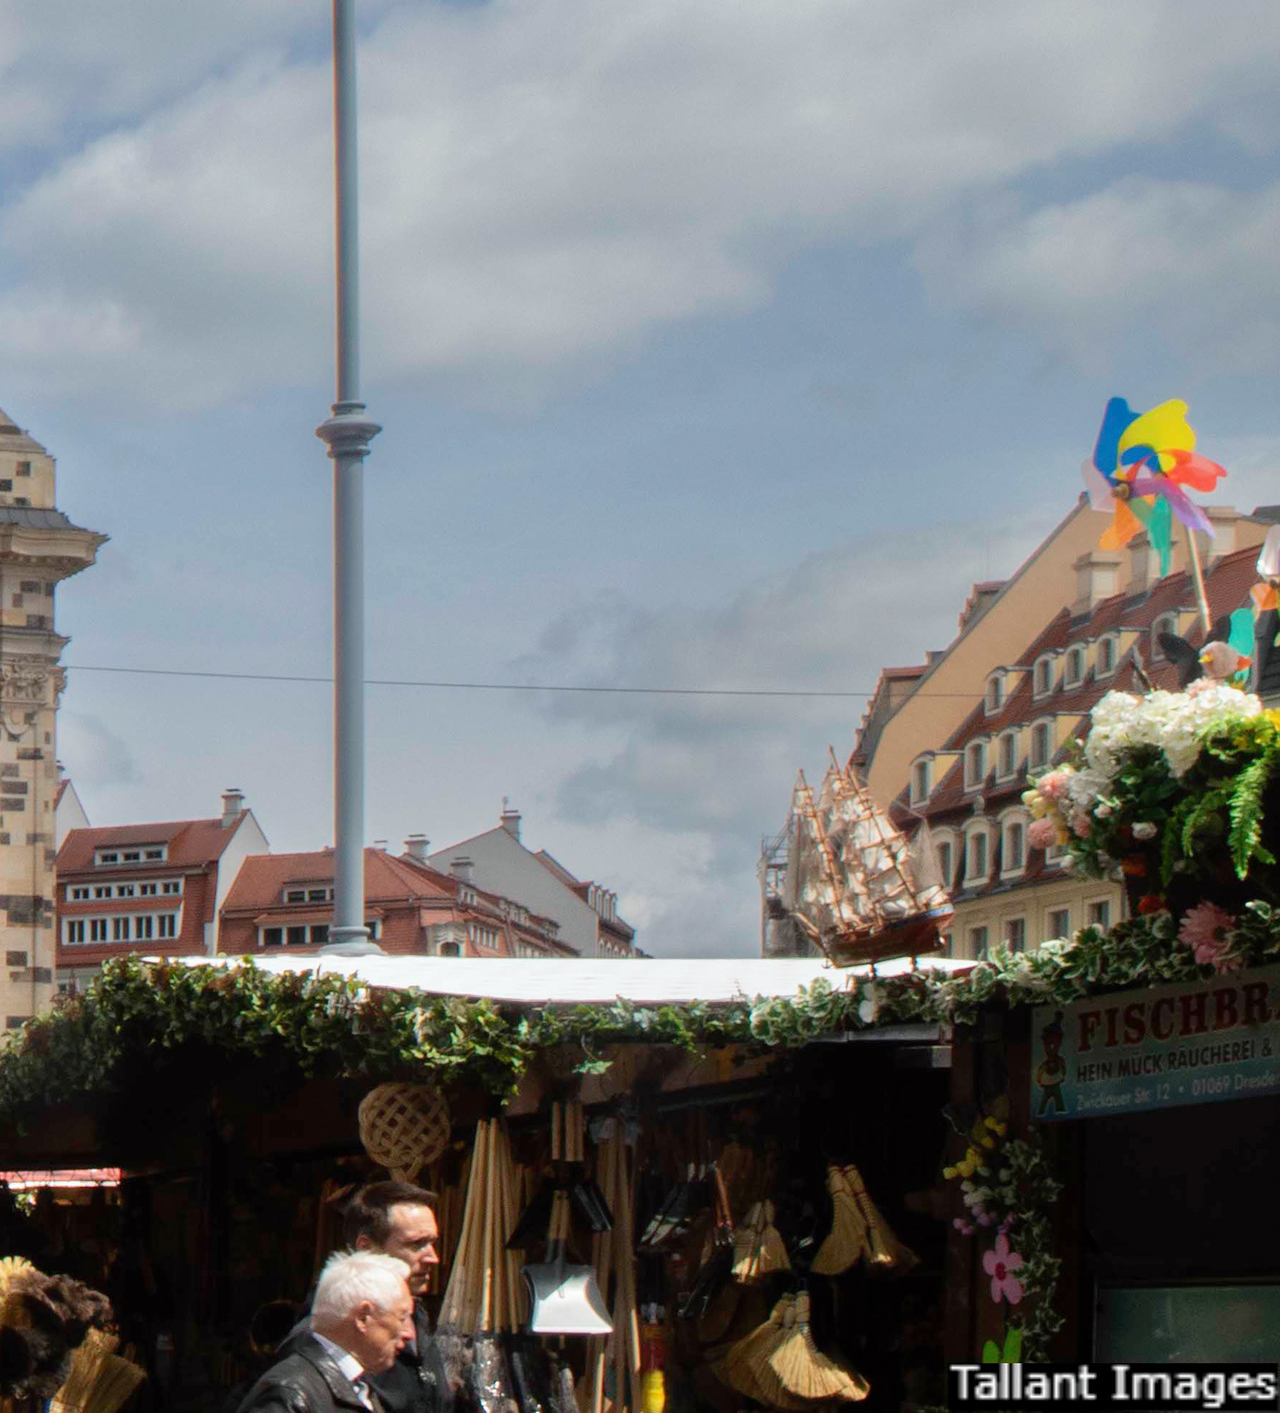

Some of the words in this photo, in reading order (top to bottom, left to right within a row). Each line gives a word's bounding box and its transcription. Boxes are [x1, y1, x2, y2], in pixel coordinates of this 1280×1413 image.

[1077, 981, 1280, 1052] FISCHBR
[1077, 1062, 1113, 1083] HEIN
[1156, 1083, 1171, 1101] 12
